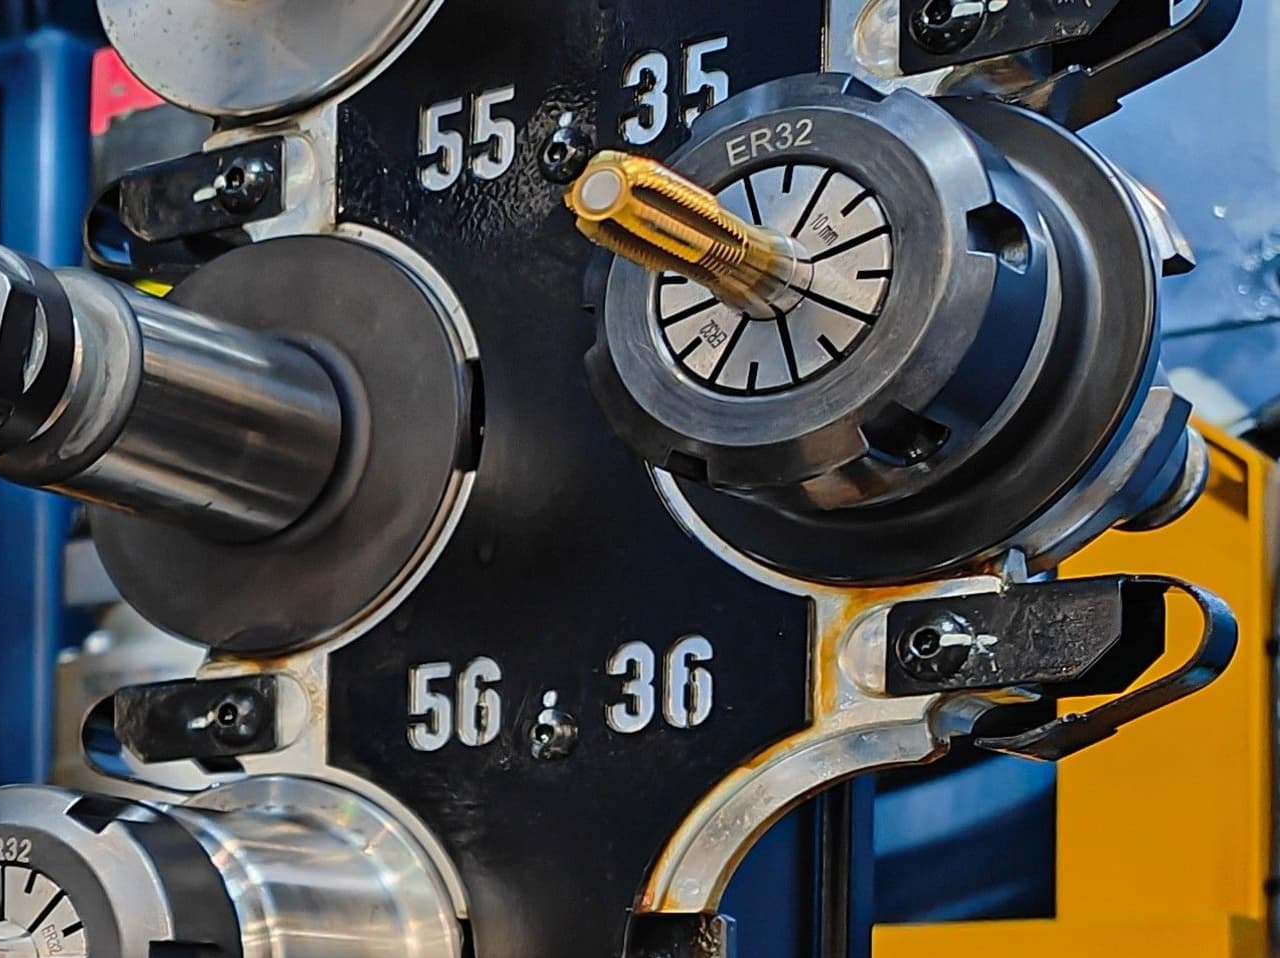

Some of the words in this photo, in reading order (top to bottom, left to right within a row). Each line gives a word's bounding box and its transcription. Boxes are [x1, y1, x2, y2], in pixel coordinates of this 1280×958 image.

[418, 84, 516, 192] 55
[618, 36, 730, 145] 35
[726, 117, 814, 167] ER32
[406, 656, 503, 752] 56
[604, 634, 714, 735] 36
